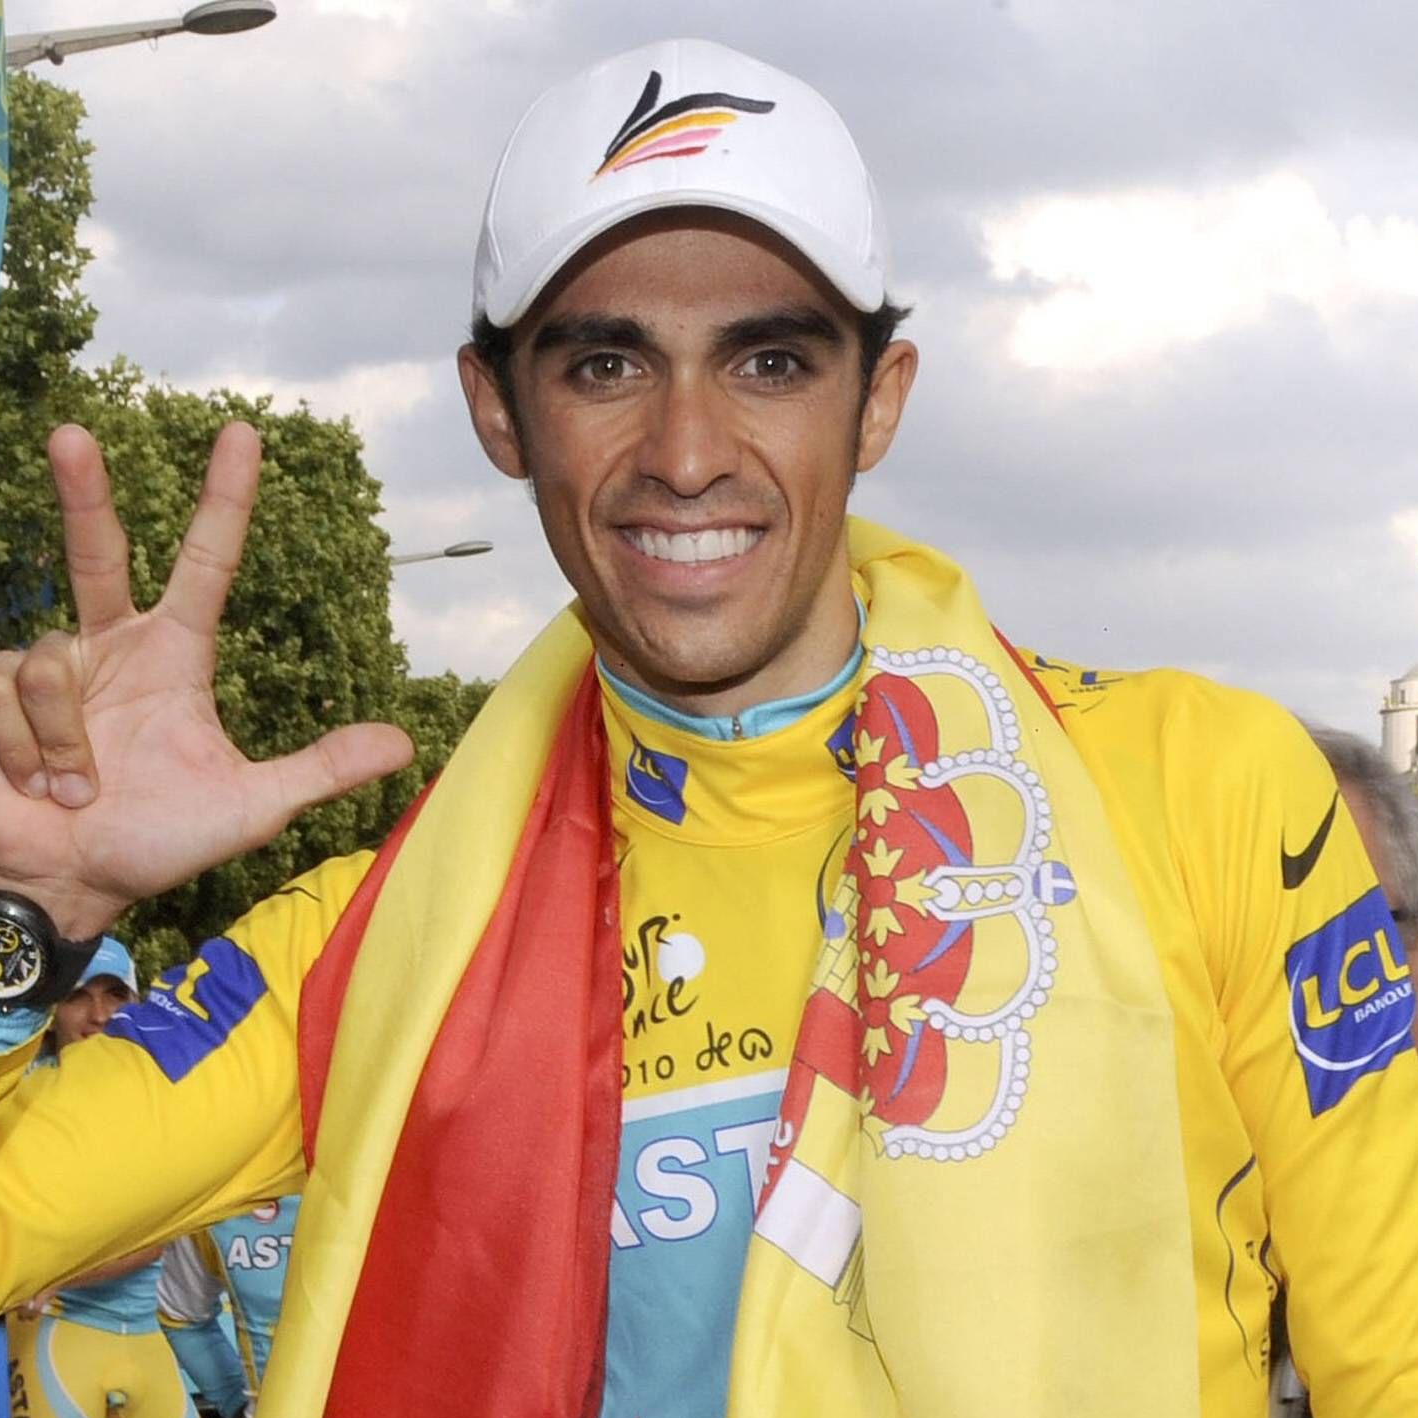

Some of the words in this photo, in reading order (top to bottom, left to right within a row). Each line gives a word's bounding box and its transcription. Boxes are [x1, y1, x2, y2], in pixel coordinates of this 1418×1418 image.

[1301, 928, 1410, 1029] LCL
[1354, 982, 1412, 1023] BANQU
[226, 1234, 294, 1270] AST
